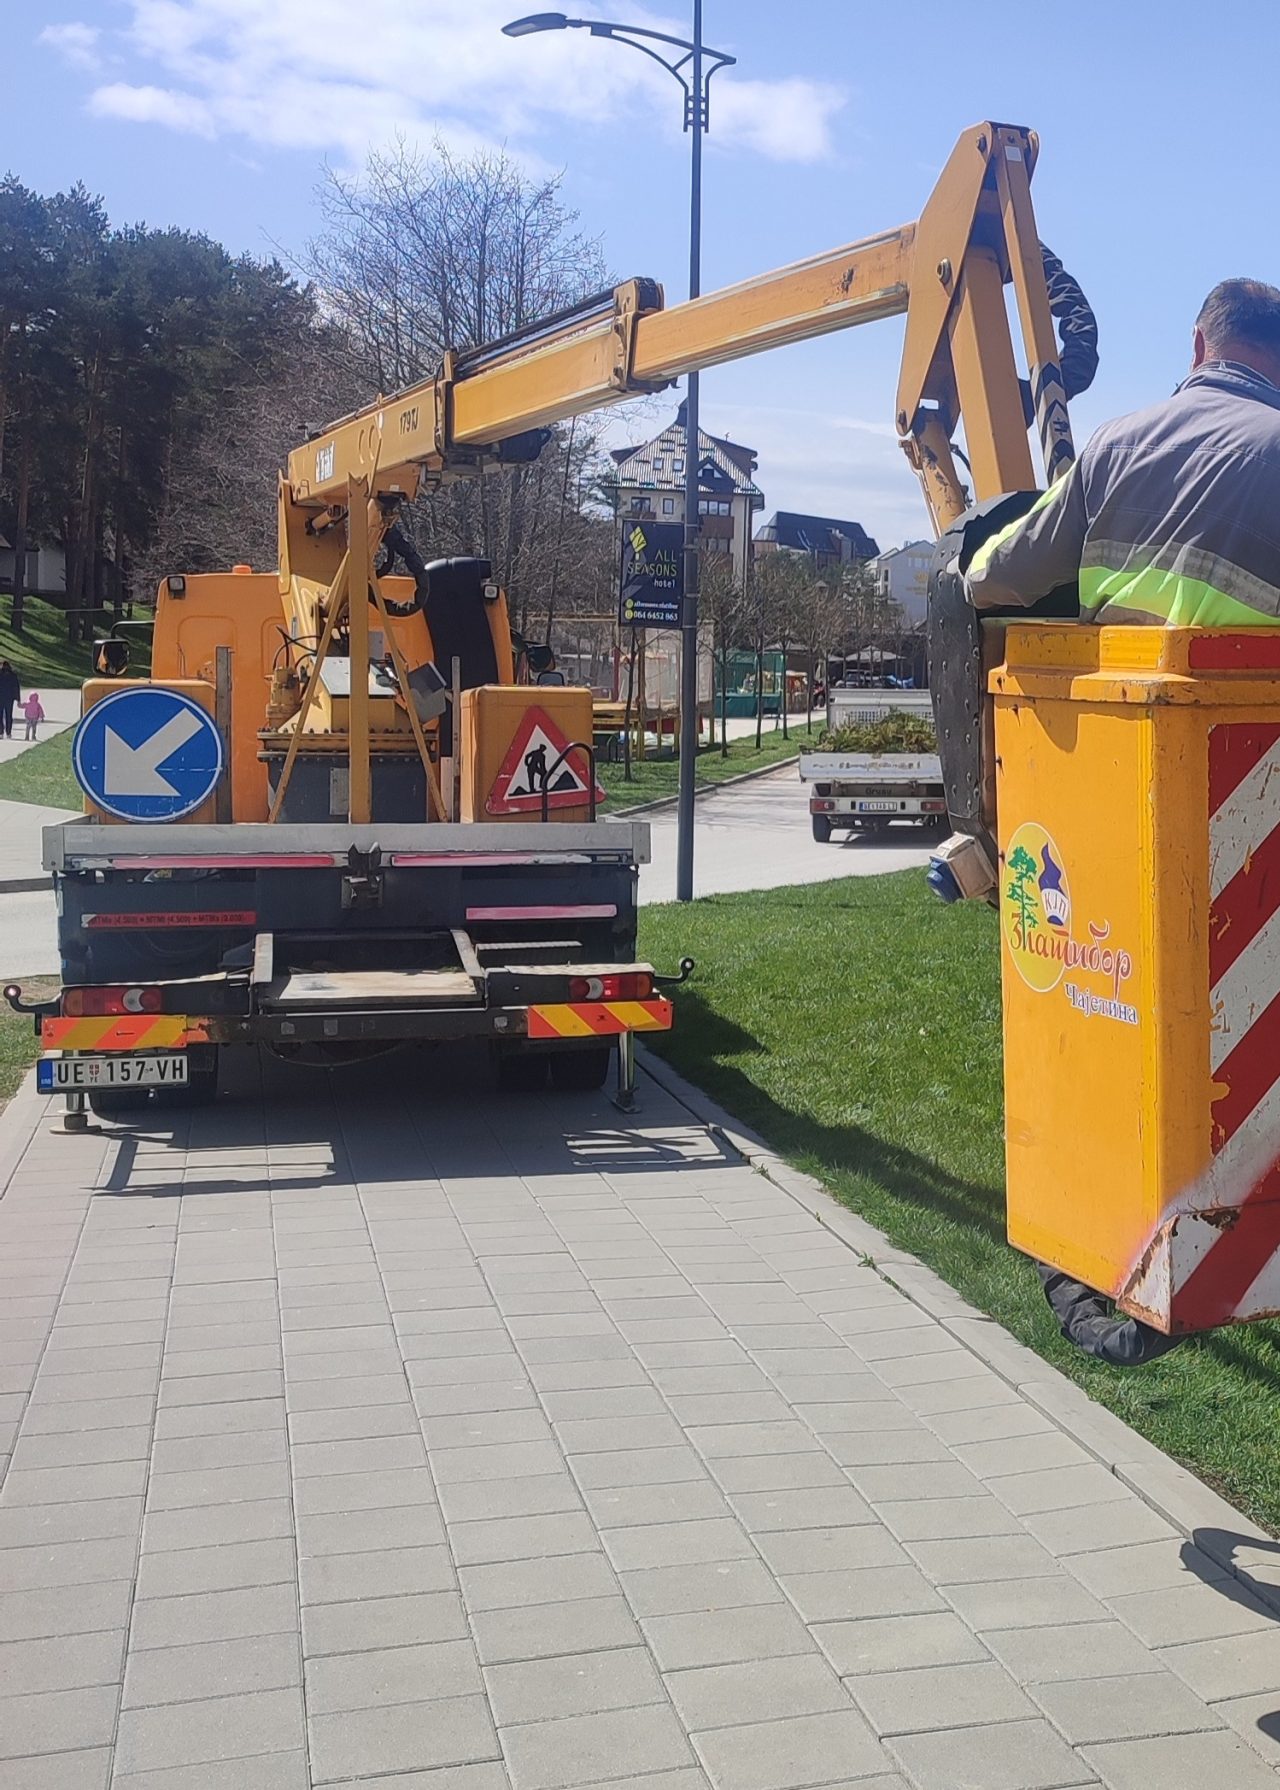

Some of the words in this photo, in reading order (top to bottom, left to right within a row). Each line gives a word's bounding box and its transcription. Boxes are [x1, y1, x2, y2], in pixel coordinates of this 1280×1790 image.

[655, 549, 677, 562] ALL
[627, 562, 678, 577] SEASONS
[653, 579, 676, 589] hotel
[1065, 982, 1138, 1024] Чајетина
[57, 1063, 84, 1084] UE
